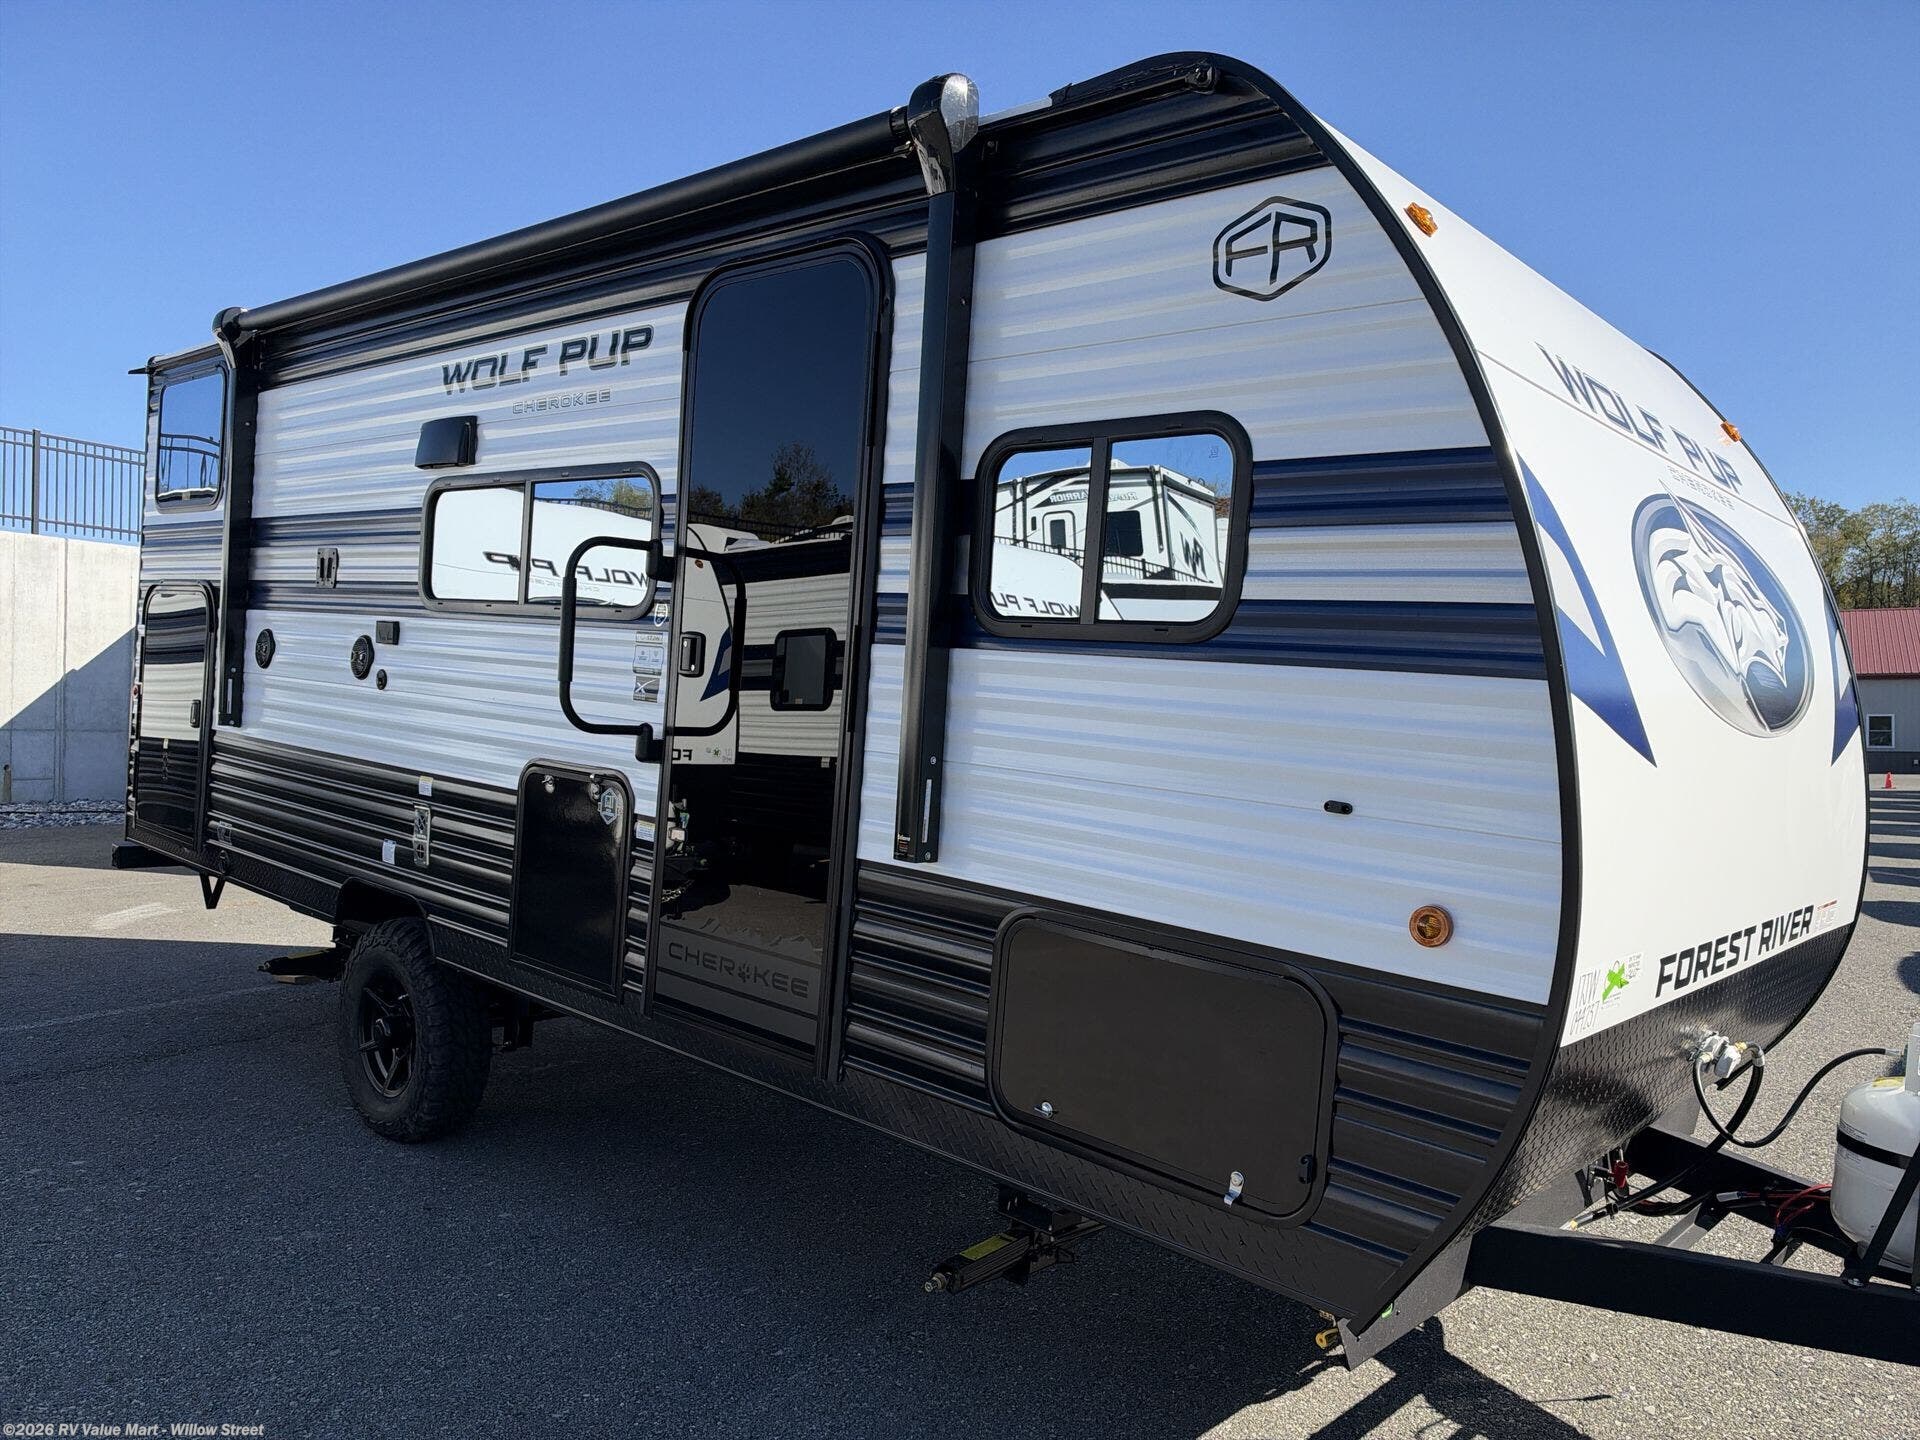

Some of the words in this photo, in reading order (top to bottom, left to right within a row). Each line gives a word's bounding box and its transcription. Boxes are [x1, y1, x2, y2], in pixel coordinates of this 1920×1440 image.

[442, 344, 548, 395] WOLF
[559, 324, 654, 376] PUP
[512, 389, 611, 414] CHEROKEE
[1534, 341, 1669, 454] WOLF
[1669, 425, 1742, 494] PUP
[1655, 925, 1757, 998] FOREST
[1758, 905, 1814, 956] RIVER
